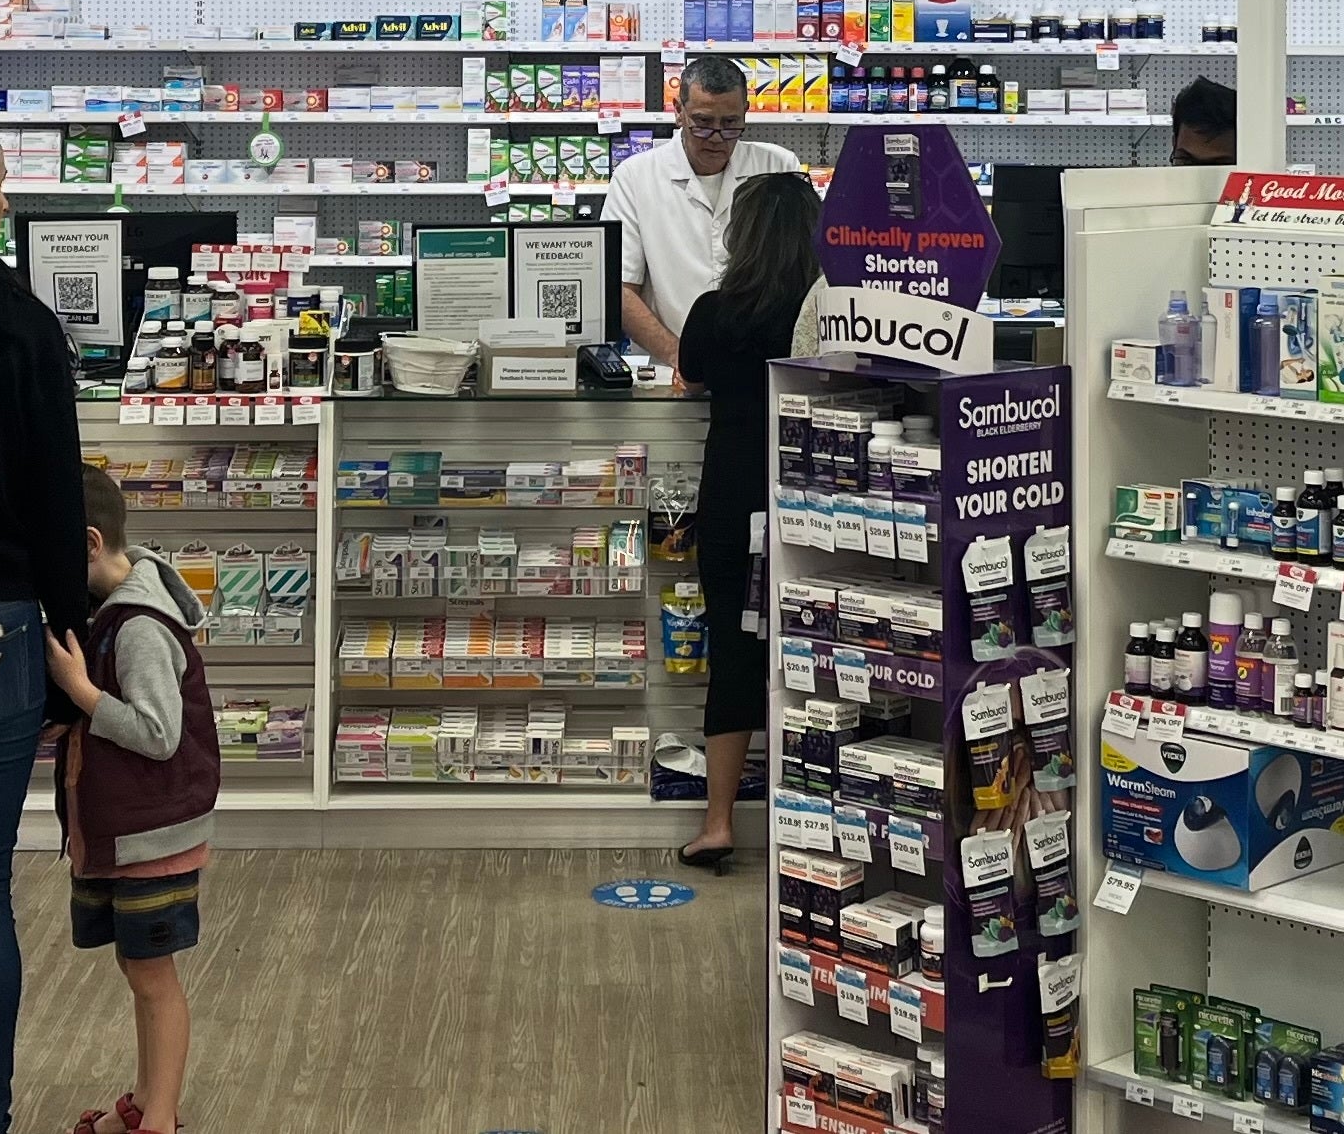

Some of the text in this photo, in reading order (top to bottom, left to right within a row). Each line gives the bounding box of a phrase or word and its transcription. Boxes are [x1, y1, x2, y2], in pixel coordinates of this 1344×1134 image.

[341, 23, 366, 32] Advil
[381, 23, 406, 32] Advil
[422, 22, 448, 31] Advil
[1260, 181, 1306, 200] Good
[1251, 209, 1268, 222] let
[1272, 211, 1291, 223] the
[1294, 214, 1331, 225] stress
[526, 241, 539, 249] WE
[826, 226, 985, 252] Clinically proven
[536, 252, 583, 260] FEEDBACK!
[865, 253, 938, 274] Shorten
[908, 277, 949, 296] cold
[820, 298, 969, 361] ambucol
[959, 385, 1060, 429] Sambucol
[977, 421, 1042, 438] BLACK ELDERBERRY
[967, 450, 1052, 485] SHORTEN
[955, 482, 1065, 519] YOUR COLD
[900, 530, 923, 541] $20.95
[1279, 579, 1311, 593] 30% OFF
[866, 664, 935, 689] OUR COLD
[1124, 712, 1137, 722] OFF
[1165, 718, 1181, 728] OFF
[1162, 751, 1184, 761] VICKS
[1107, 773, 1176, 799] WarmSteam
[1198, 1012, 1234, 1026] nicorette
[1286, 1029, 1318, 1044] nicorette
